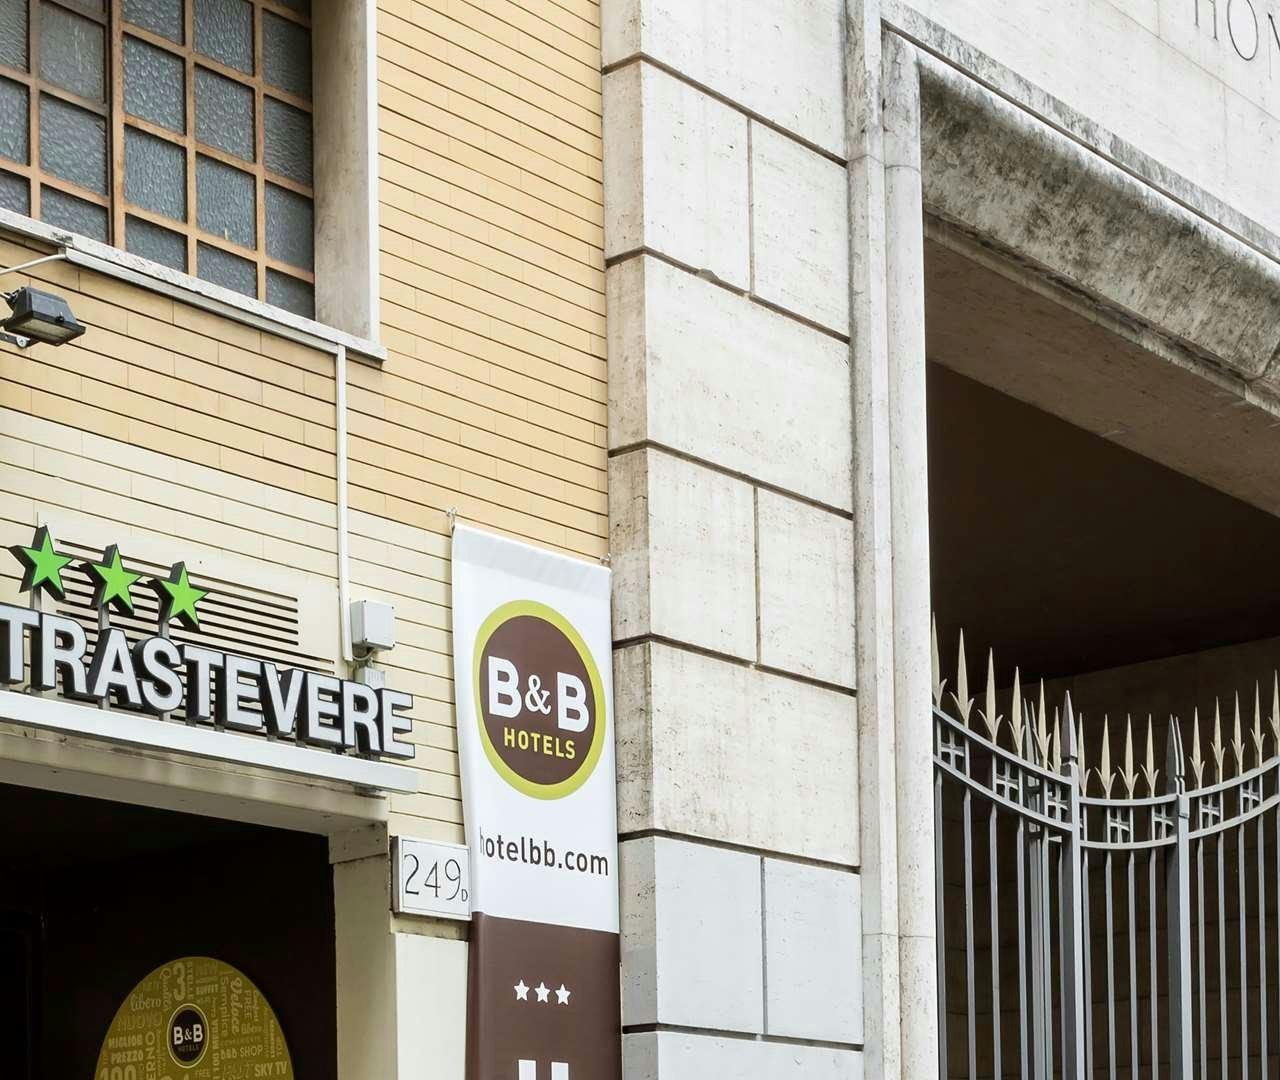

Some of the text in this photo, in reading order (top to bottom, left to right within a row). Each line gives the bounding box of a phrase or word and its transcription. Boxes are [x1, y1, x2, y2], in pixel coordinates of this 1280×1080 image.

[488, 655, 589, 733] B&B
[503, 726, 576, 761] HOTELS
[479, 826, 609, 876] hotelbb.com
[173, 1023, 203, 1045] B&B
[110, 1049, 144, 1065] PREZZO
[240, 1044, 263, 1057] SHOP
[254, 1060, 288, 1077] SKY TV
